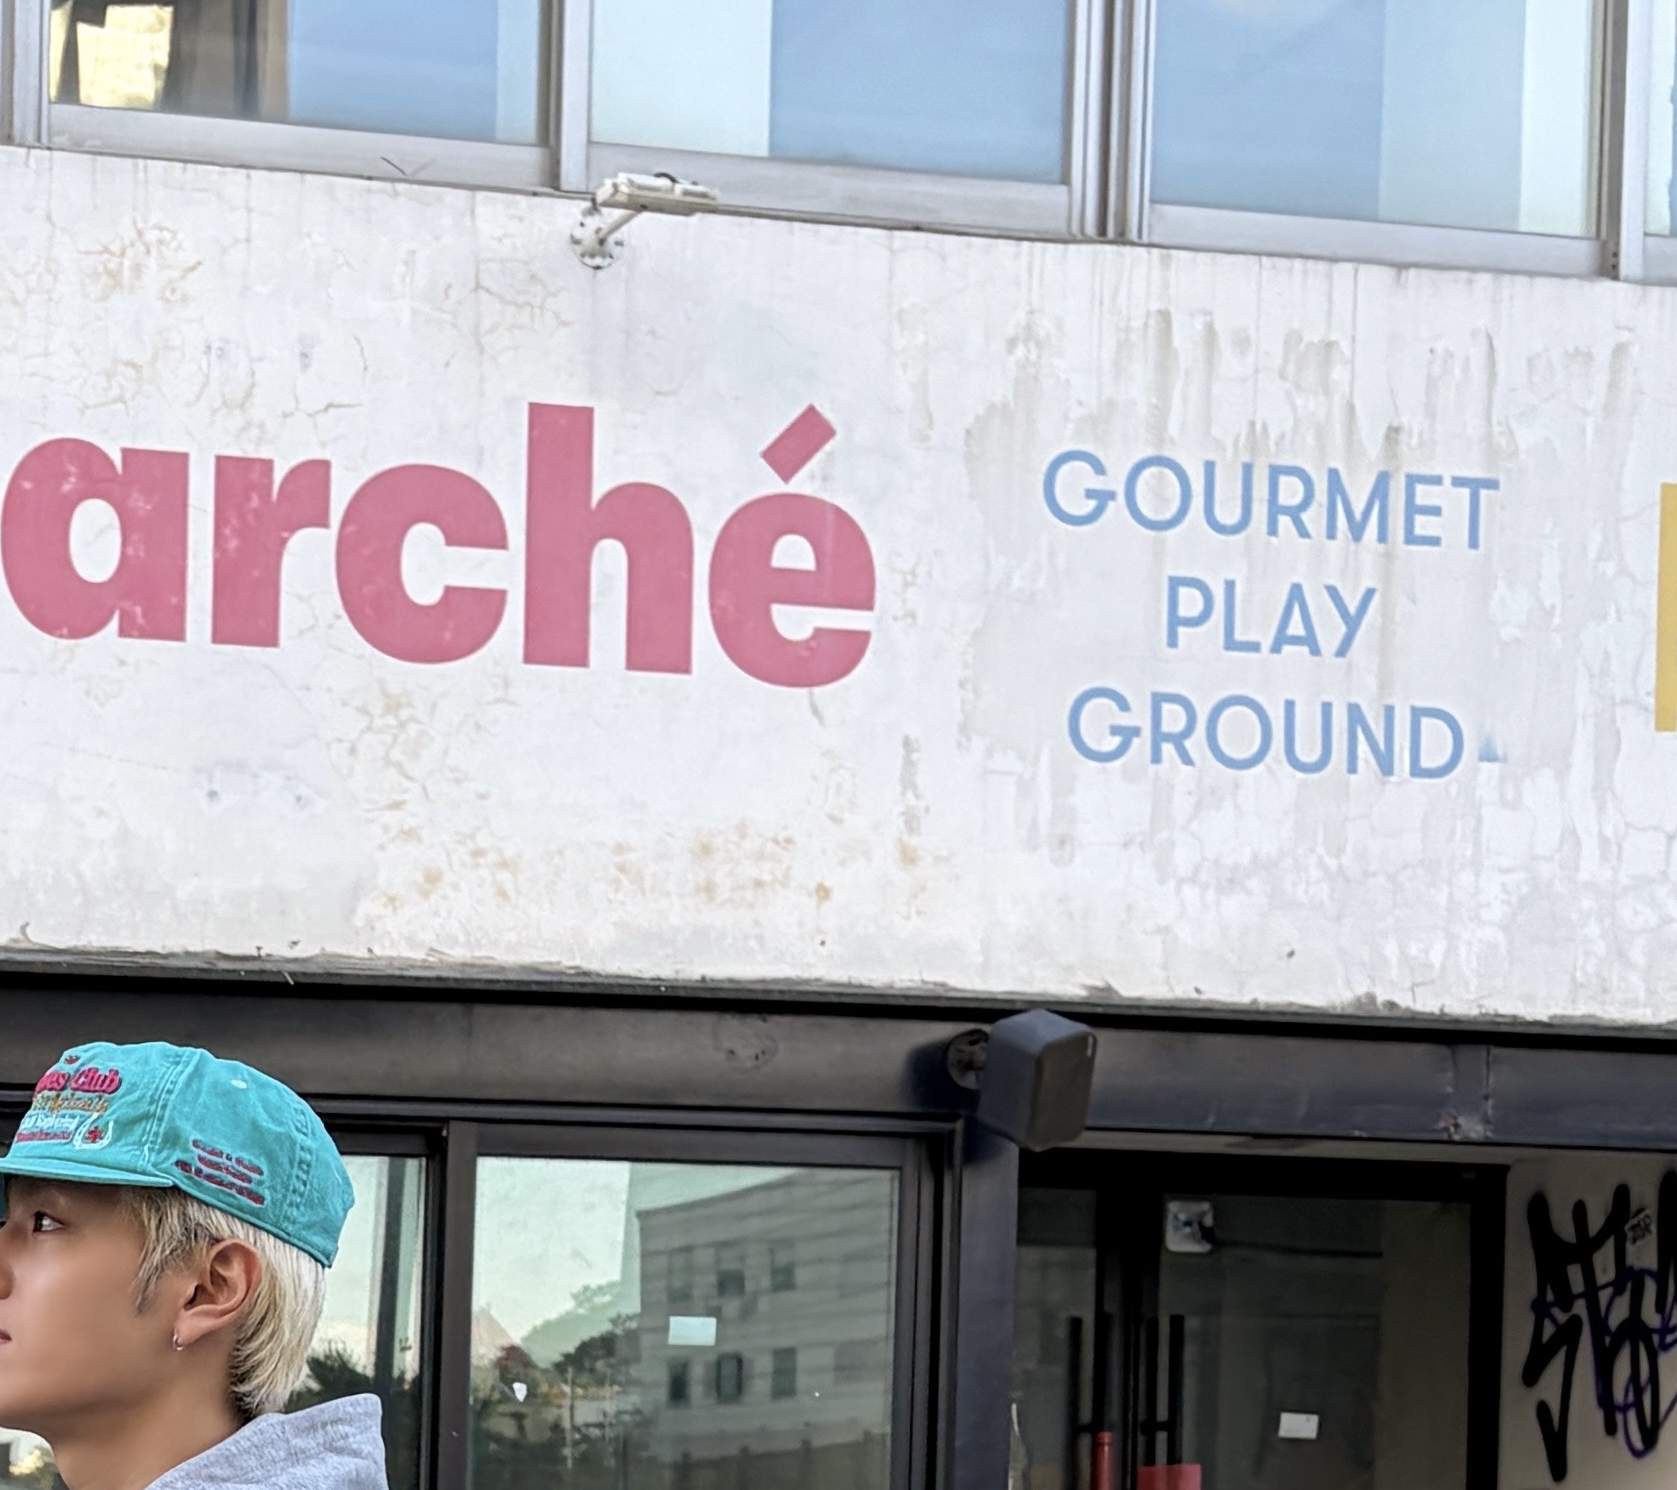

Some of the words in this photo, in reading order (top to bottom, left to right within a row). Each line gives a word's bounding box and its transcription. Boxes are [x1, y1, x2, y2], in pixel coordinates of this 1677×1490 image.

[1042, 448, 1501, 551] GOURMET
[1165, 575, 1377, 660] PLAY
[1067, 686, 1465, 780] GROUND
